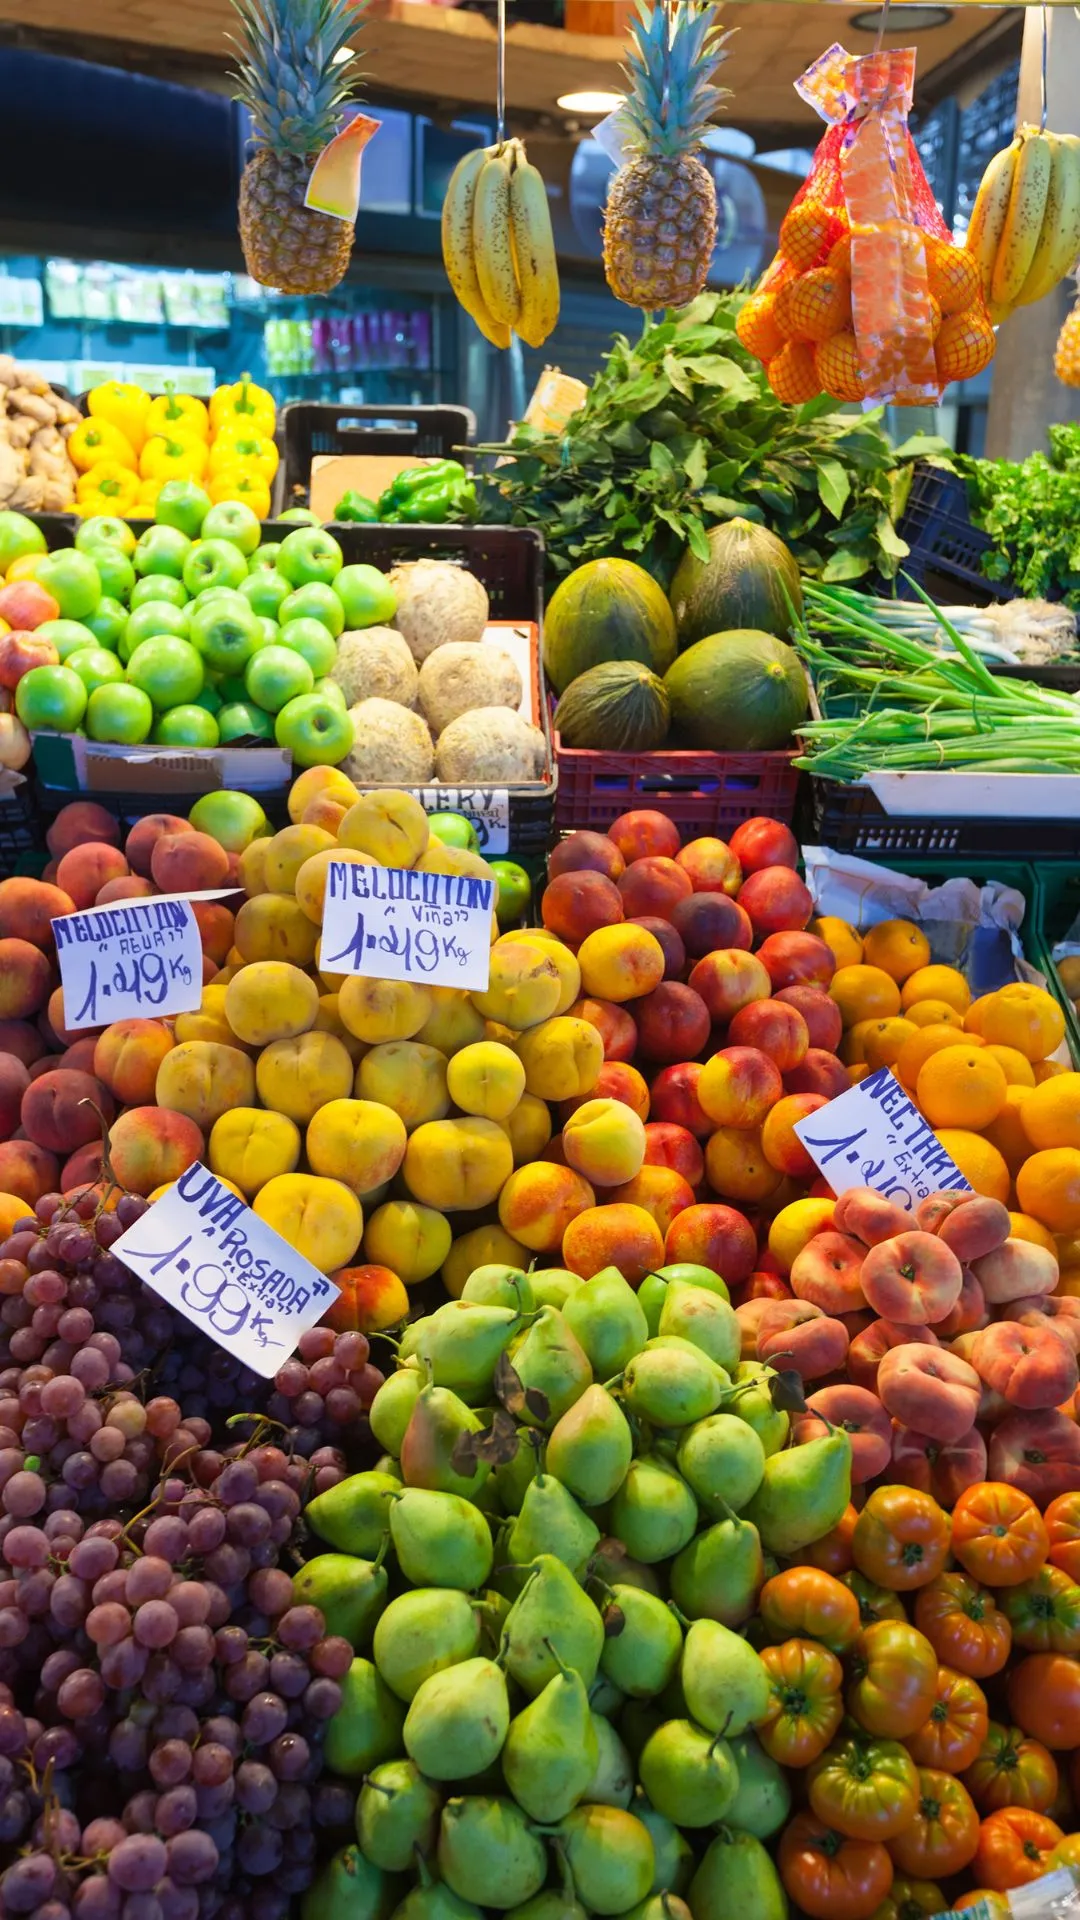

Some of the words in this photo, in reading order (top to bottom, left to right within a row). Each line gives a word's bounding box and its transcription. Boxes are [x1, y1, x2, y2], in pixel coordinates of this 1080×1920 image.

[409, 788, 494, 812] LERY
[330, 862, 492, 911] MELOCOTON
[52, 900, 190, 950] MELOCOTON
[169, 953, 192, 986] Kg
[442, 935, 473, 967] Kg
[177, 1161, 248, 1232] UVA
[122, 1234, 251, 1336] 1.99
